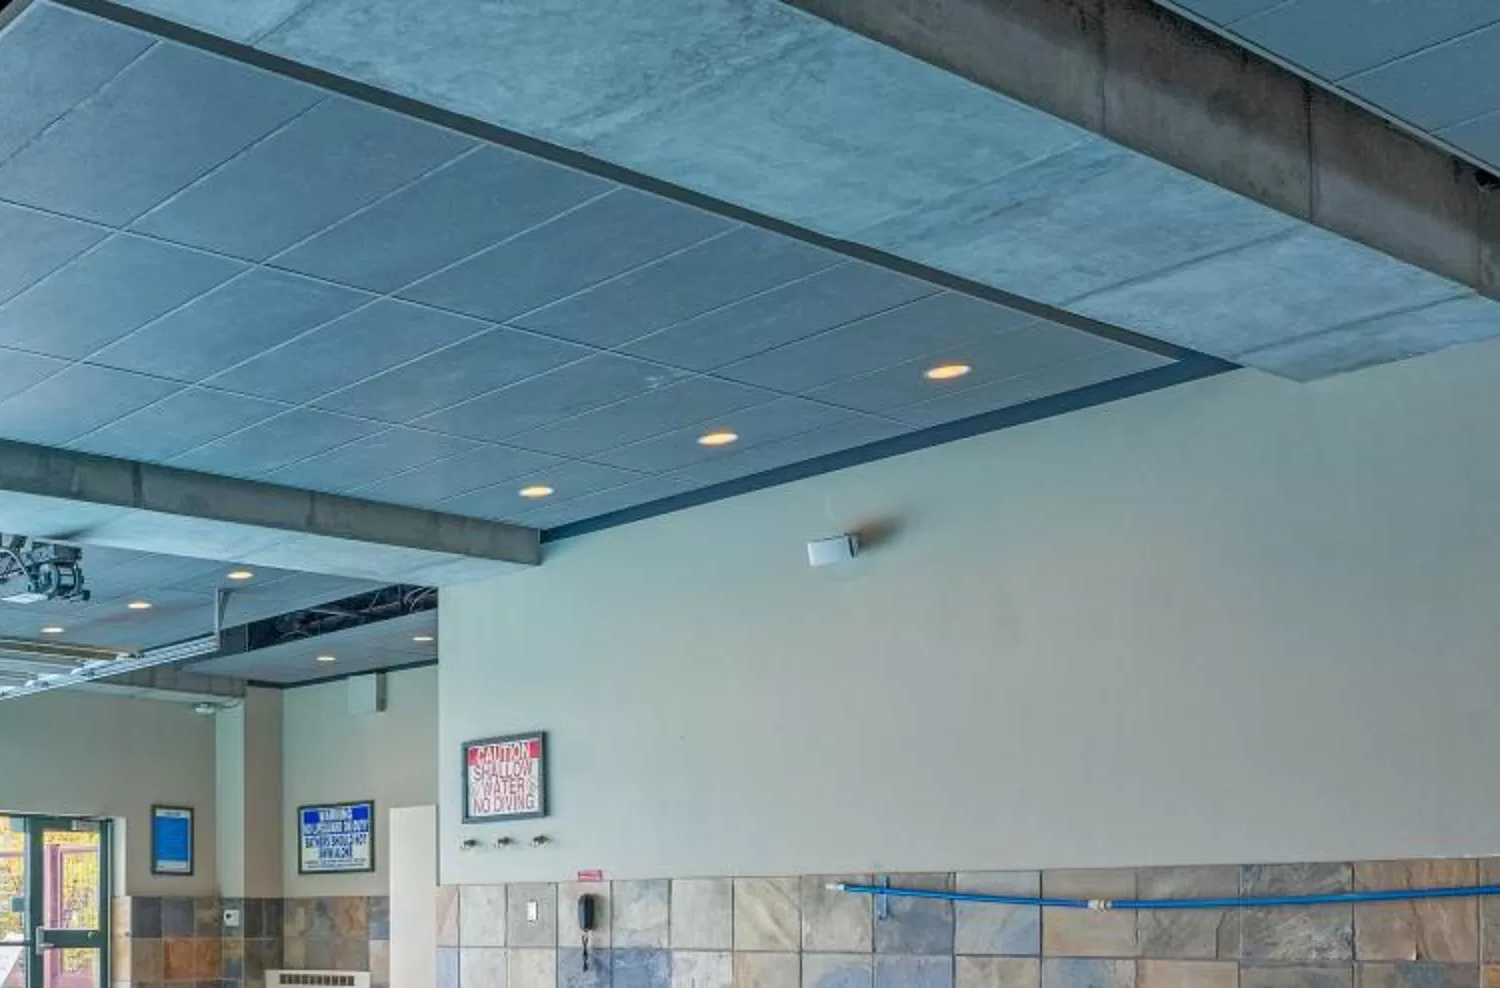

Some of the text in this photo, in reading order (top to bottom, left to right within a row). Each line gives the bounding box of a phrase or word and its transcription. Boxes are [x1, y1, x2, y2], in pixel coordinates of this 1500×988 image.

[476, 741, 529, 764] CAUTION
[473, 758, 532, 781] SHALLOW
[482, 776, 526, 798] WATER
[474, 794, 534, 814] NO DIVING
